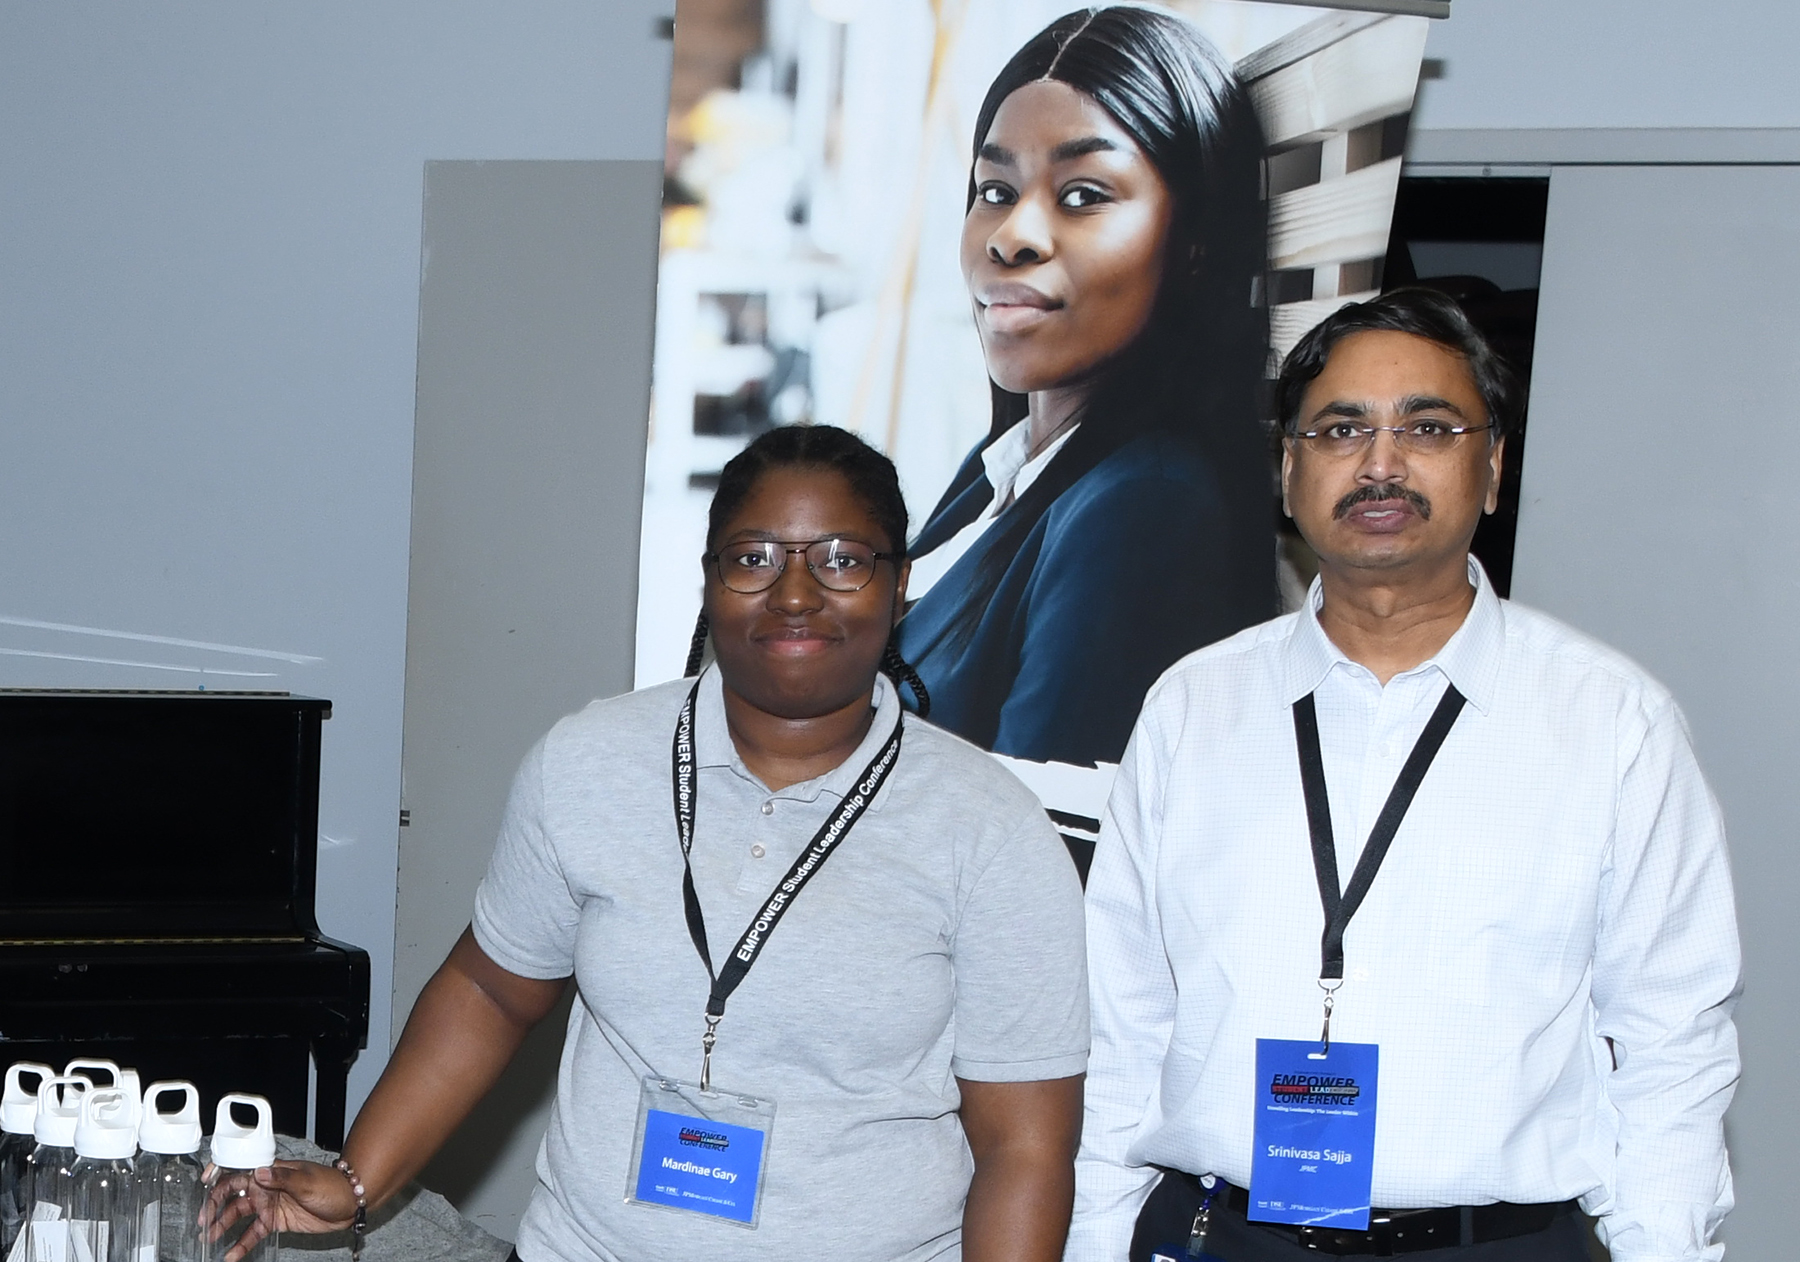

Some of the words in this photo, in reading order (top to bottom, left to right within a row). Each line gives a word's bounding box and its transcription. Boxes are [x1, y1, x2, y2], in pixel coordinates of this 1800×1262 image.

[678, 764, 692, 813] Student
[680, 814, 692, 853] Lead
[736, 892, 789, 963] EMPOWER
[782, 850, 821, 893] Student
[813, 795, 864, 854] Leadership
[859, 739, 899, 796] Conference
[1272, 1074, 1355, 1087] EMPOWER
[1274, 1094, 1355, 1106] CONFERENCE
[680, 1127, 728, 1141] EMPOWER
[1267, 1145, 1321, 1160] Srinivasa
[1323, 1149, 1352, 1165] Sajja
[661, 1157, 711, 1177] Mardinae
[712, 1168, 738, 1184] Gary
